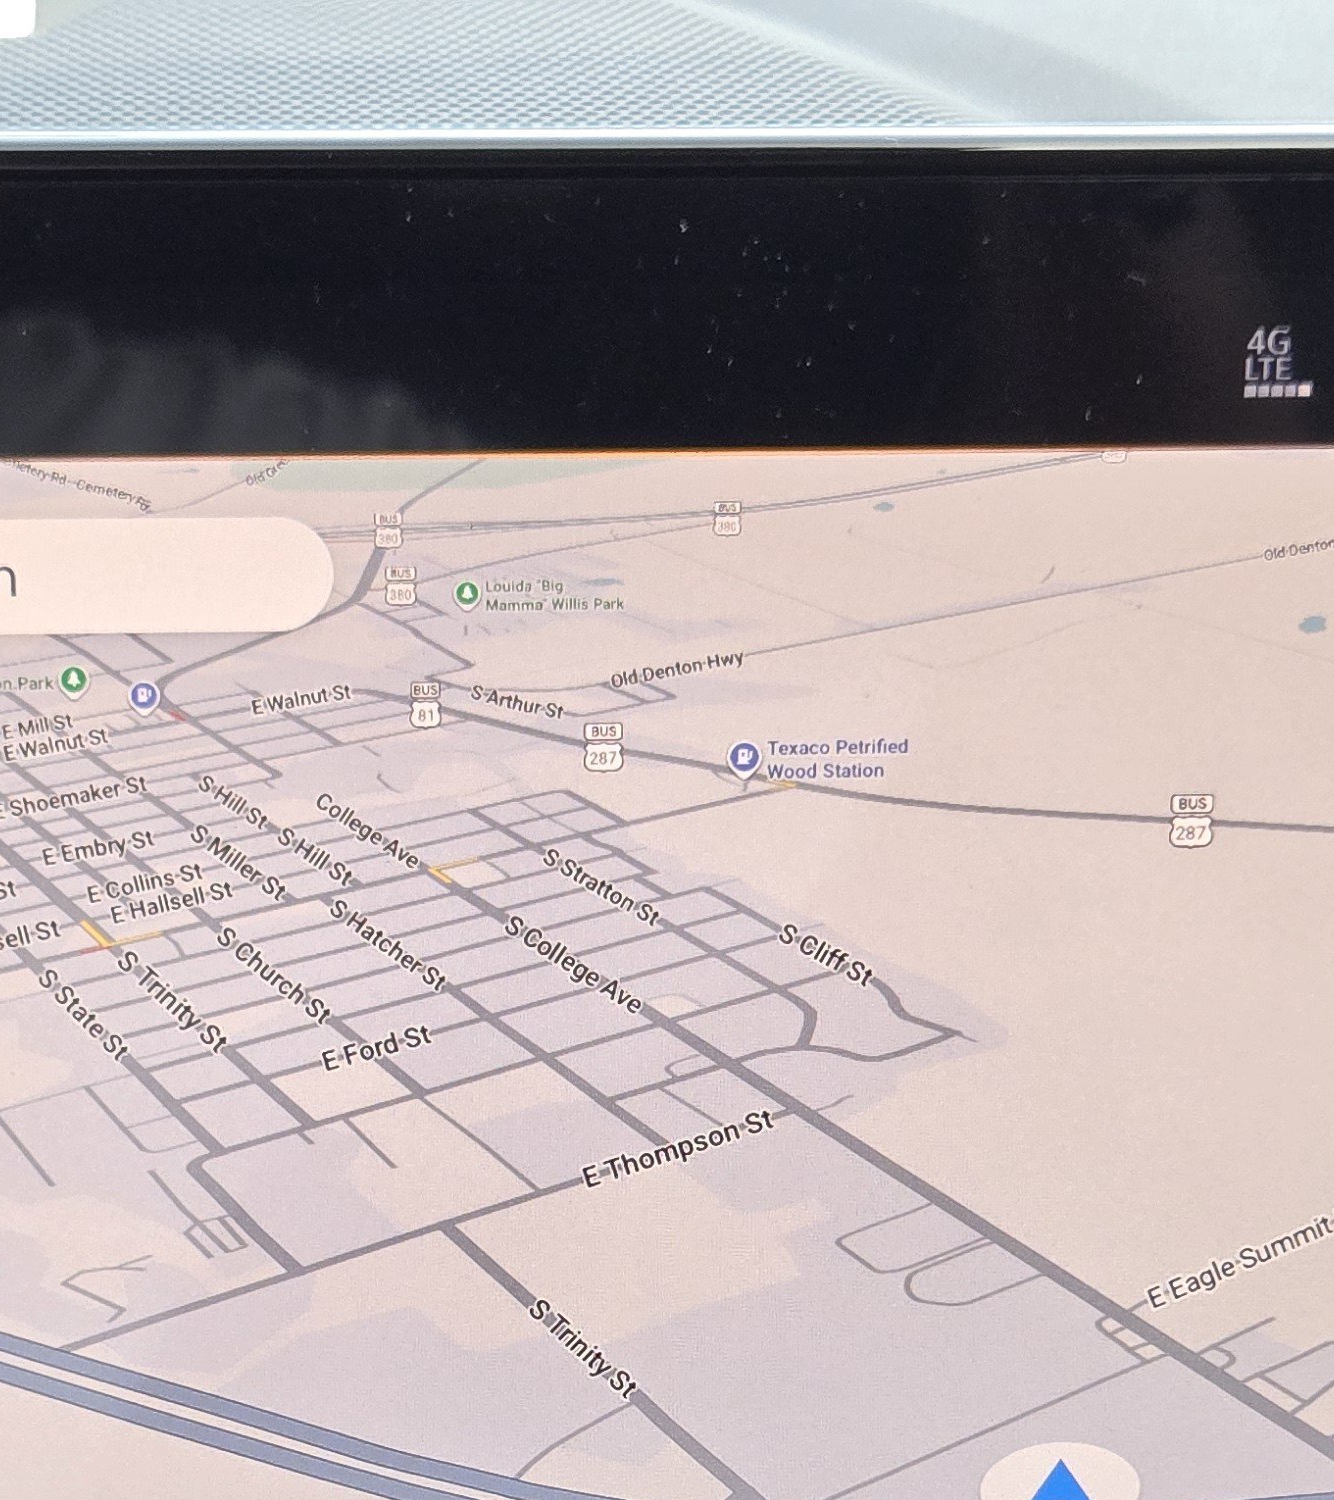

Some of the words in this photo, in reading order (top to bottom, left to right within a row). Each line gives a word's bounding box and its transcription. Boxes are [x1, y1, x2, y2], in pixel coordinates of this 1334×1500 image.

[1248, 327, 1291, 357] 4G
[1245, 357, 1291, 381] LTE
[18, 675, 54, 691] Park
[611, 667, 636, 689] Old
[643, 658, 702, 683] Denton
[707, 652, 744, 671] Hwy
[251, 699, 265, 716] E
[268, 688, 328, 713] Walnut
[331, 684, 351, 703] St
[413, 684, 437, 696] BUS
[471, 684, 483, 702] S
[486, 688, 542, 718] Arthur
[546, 702, 565, 720] St
[3, 722, 14, 740] E
[18, 716, 50, 738] Mill
[53, 713, 73, 733] St
[418, 707, 435, 723] 81
[591, 726, 616, 738] BUS
[4, 745, 17, 762] E
[19, 732, 84, 760] Walnut
[88, 728, 109, 748] St
[590, 751, 617, 767] 287
[768, 740, 829, 755] Texaco
[836, 738, 909, 756] Petrified
[768, 763, 815, 779] Wood
[823, 762, 884, 779] Station
[9, 784, 121, 818] Shoemaker
[125, 776, 148, 795] St
[198, 775, 215, 793] S
[214, 785, 247, 817] Hill
[247, 806, 269, 830] St
[1178, 798, 1207, 809] BUS
[42, 849, 57, 866] E
[61, 836, 126, 863] Embry
[132, 831, 154, 849] St
[315, 794, 383, 845] College
[378, 834, 419, 869] Ave
[1176, 825, 1206, 842] 287
[190, 825, 209, 845] S
[207, 837, 262, 887] Miller
[262, 877, 286, 902] St
[277, 827, 296, 847] S
[295, 837, 328, 871] Hill
[329, 861, 353, 886] St
[87, 886, 100, 903] E
[105, 872, 175, 900] Collins
[179, 864, 202, 883] St
[110, 906, 123, 923] E
[130, 888, 205, 920] Hallsell
[211, 882, 233, 901] St
[542, 848, 561, 870] S
[559, 861, 635, 913] Stratton
[636, 899, 661, 926] St
[36, 921, 61, 941] St
[330, 899, 349, 921] S
[347, 912, 417, 973] Hatcher
[418, 964, 446, 991] St
[504, 915, 524, 937] S
[522, 928, 599, 991] College
[599, 977, 643, 1014] Ave
[778, 924, 798, 948] S
[797, 936, 849, 977] Cliff
[846, 960, 874, 987] St
[216, 928, 236, 948] S
[235, 941, 303, 1003] Church
[305, 998, 332, 1026] St
[39, 969, 58, 989] S
[55, 986, 103, 1038] State
[102, 1033, 128, 1062] St
[118, 952, 139, 973] S
[138, 966, 198, 1032] Trinity
[200, 1025, 227, 1053] St
[321, 1051, 337, 1071] E
[343, 1031, 398, 1065] Ford
[403, 1025, 431, 1047] St
[582, 1164, 600, 1188] E
[606, 1121, 740, 1178] Thompson
[744, 1110, 774, 1136] St
[1146, 1287, 1163, 1310] E
[1169, 1257, 1235, 1300] Eagle
[1240, 1219, 1333, 1271] Summit
[530, 1299, 550, 1321] S
[550, 1312, 613, 1378] Trinity
[609, 1371, 636, 1399] St
